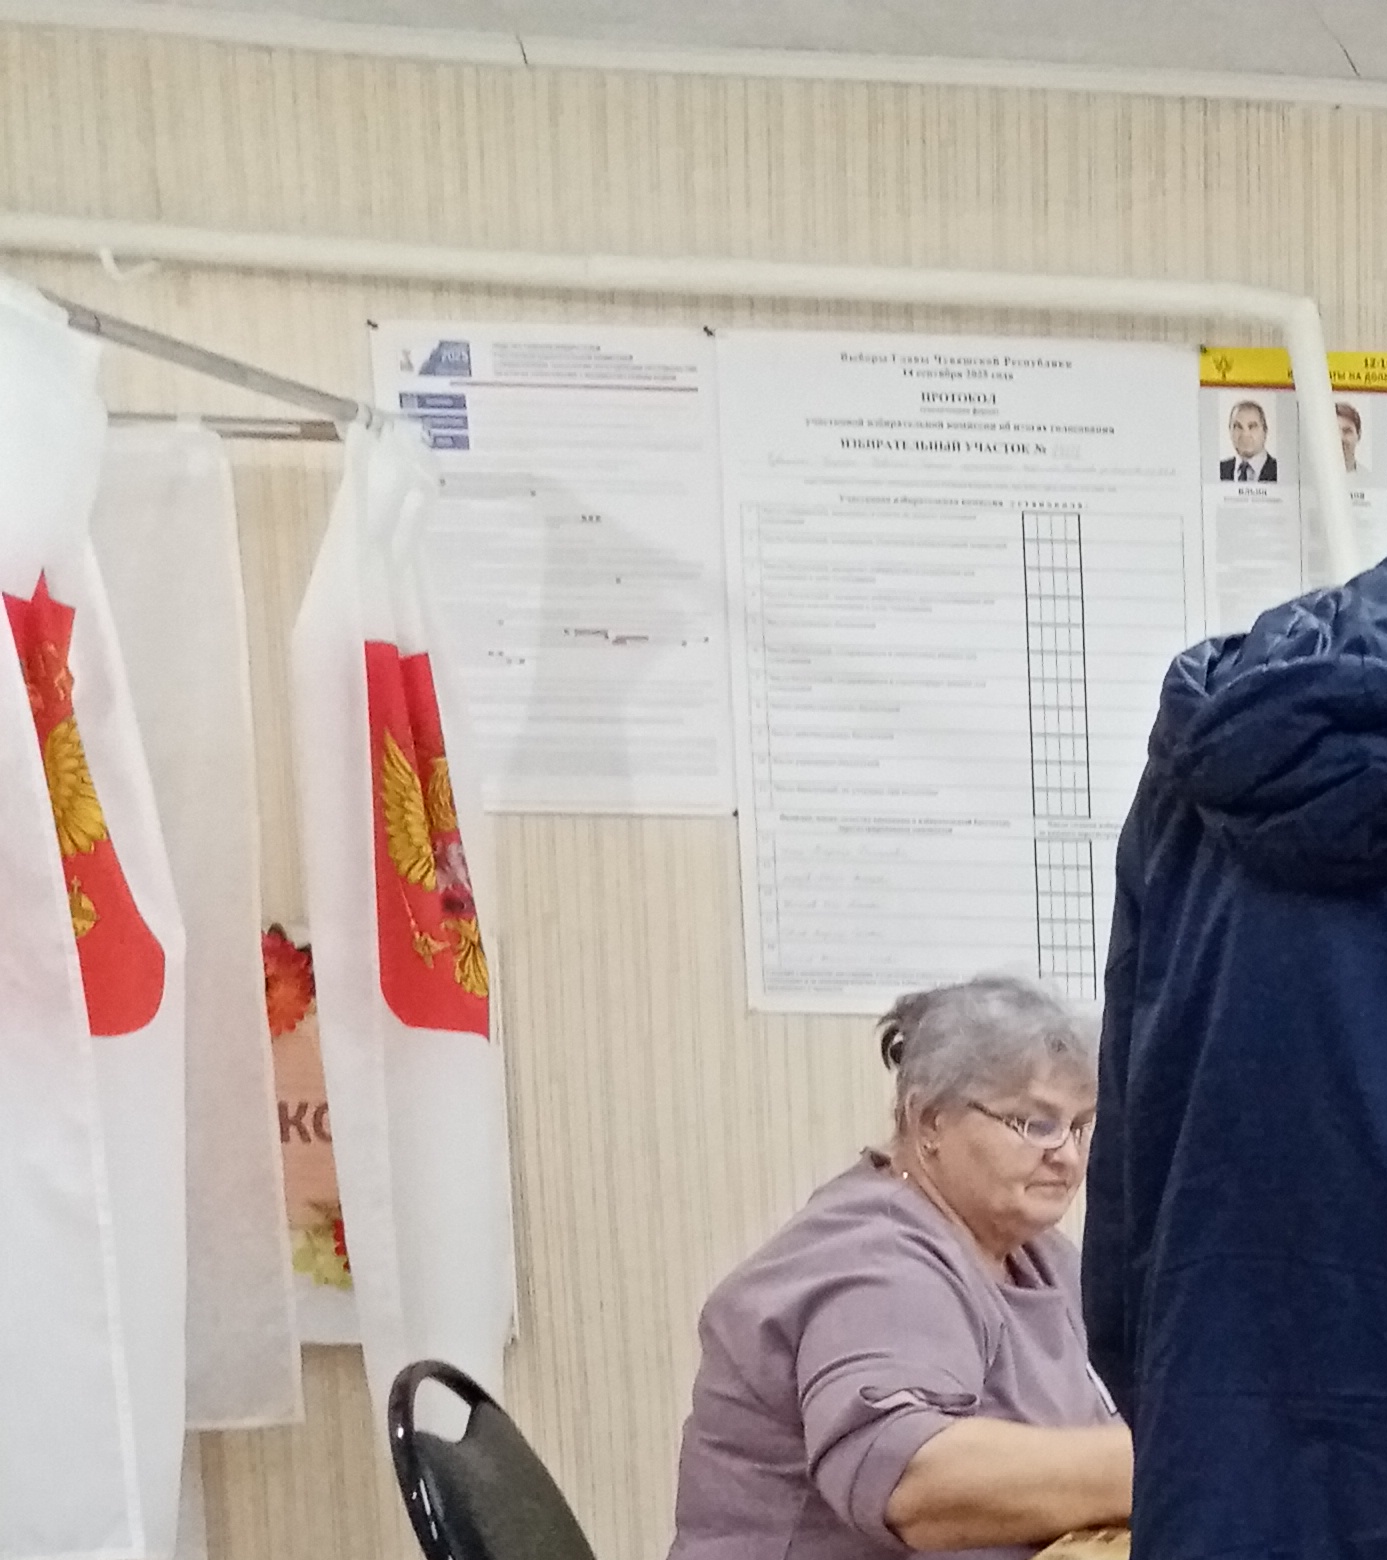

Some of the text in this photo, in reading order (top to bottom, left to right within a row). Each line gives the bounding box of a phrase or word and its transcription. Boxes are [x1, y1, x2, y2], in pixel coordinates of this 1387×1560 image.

[921, 391, 996, 404] ПРОТОКОЛ
[840, 437, 961, 452] ИЗБИРАТЕЛЬНЫЙ
[966, 440, 1030, 454] УЧАСТОК
